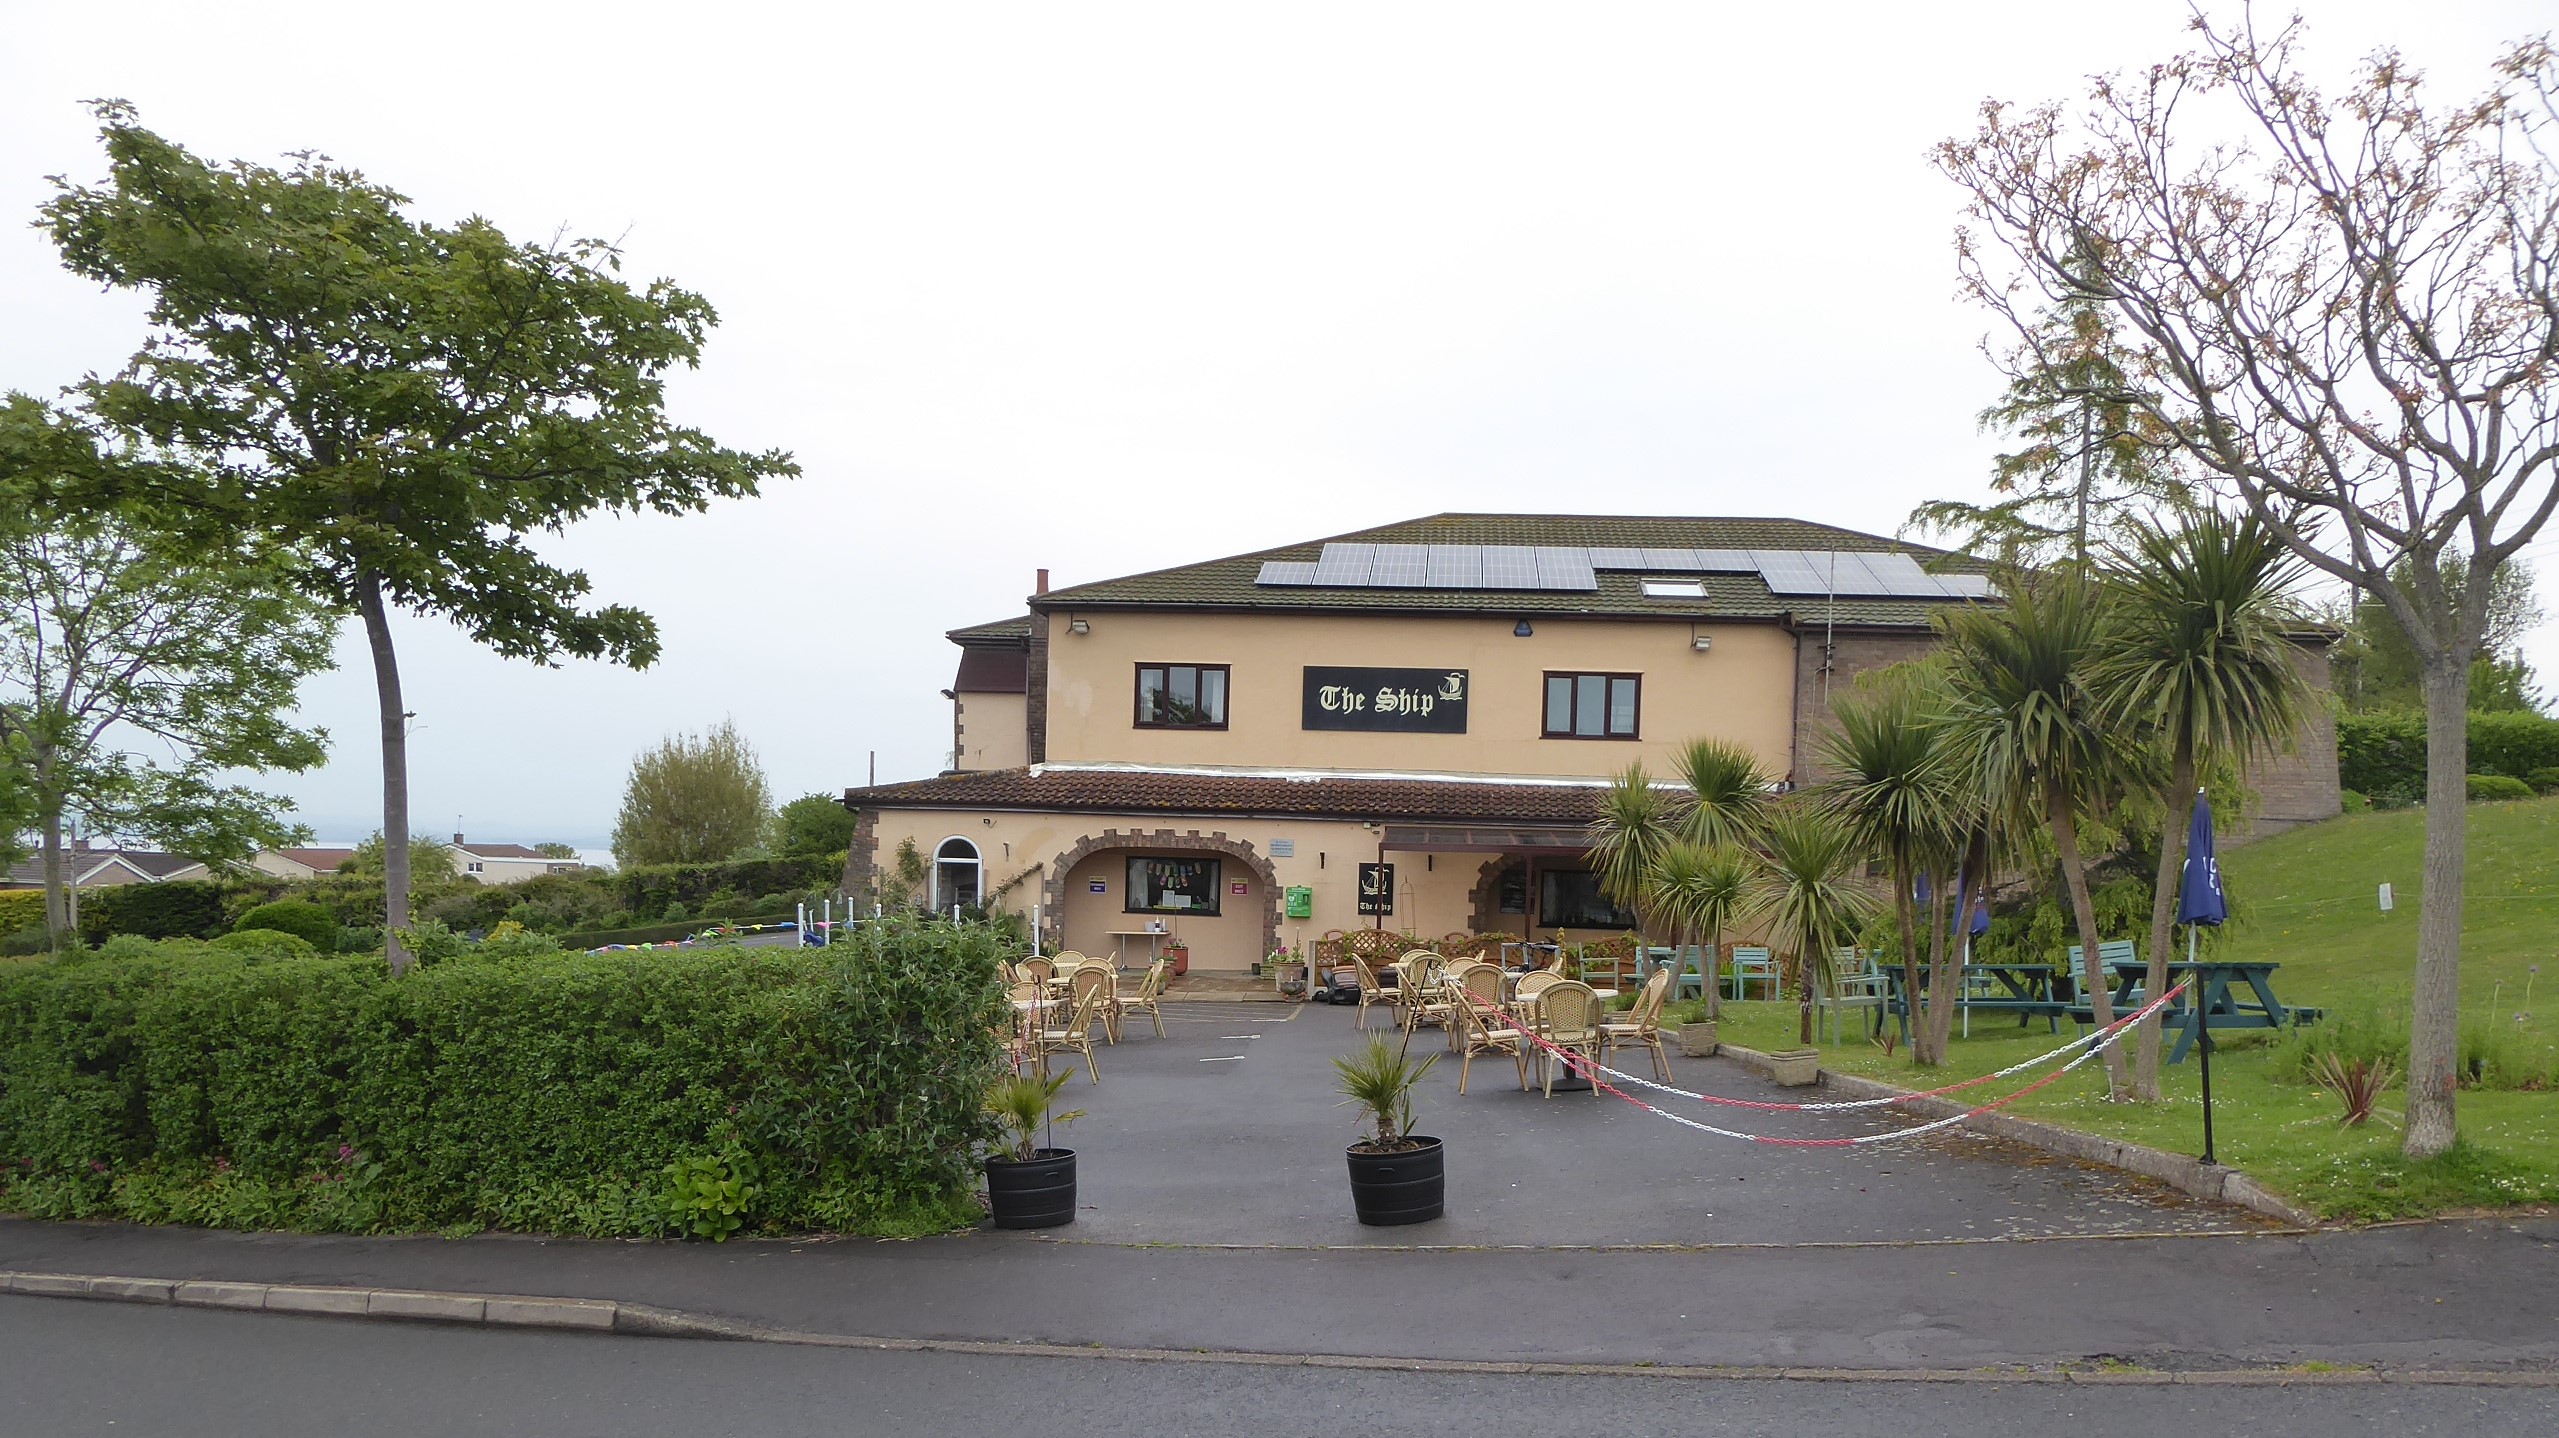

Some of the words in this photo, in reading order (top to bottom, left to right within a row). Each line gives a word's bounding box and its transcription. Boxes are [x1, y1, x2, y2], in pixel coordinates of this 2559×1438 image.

[1319, 685, 1366, 715] The
[1374, 686, 1434, 717] Ship
[1359, 902, 1374, 911] The
